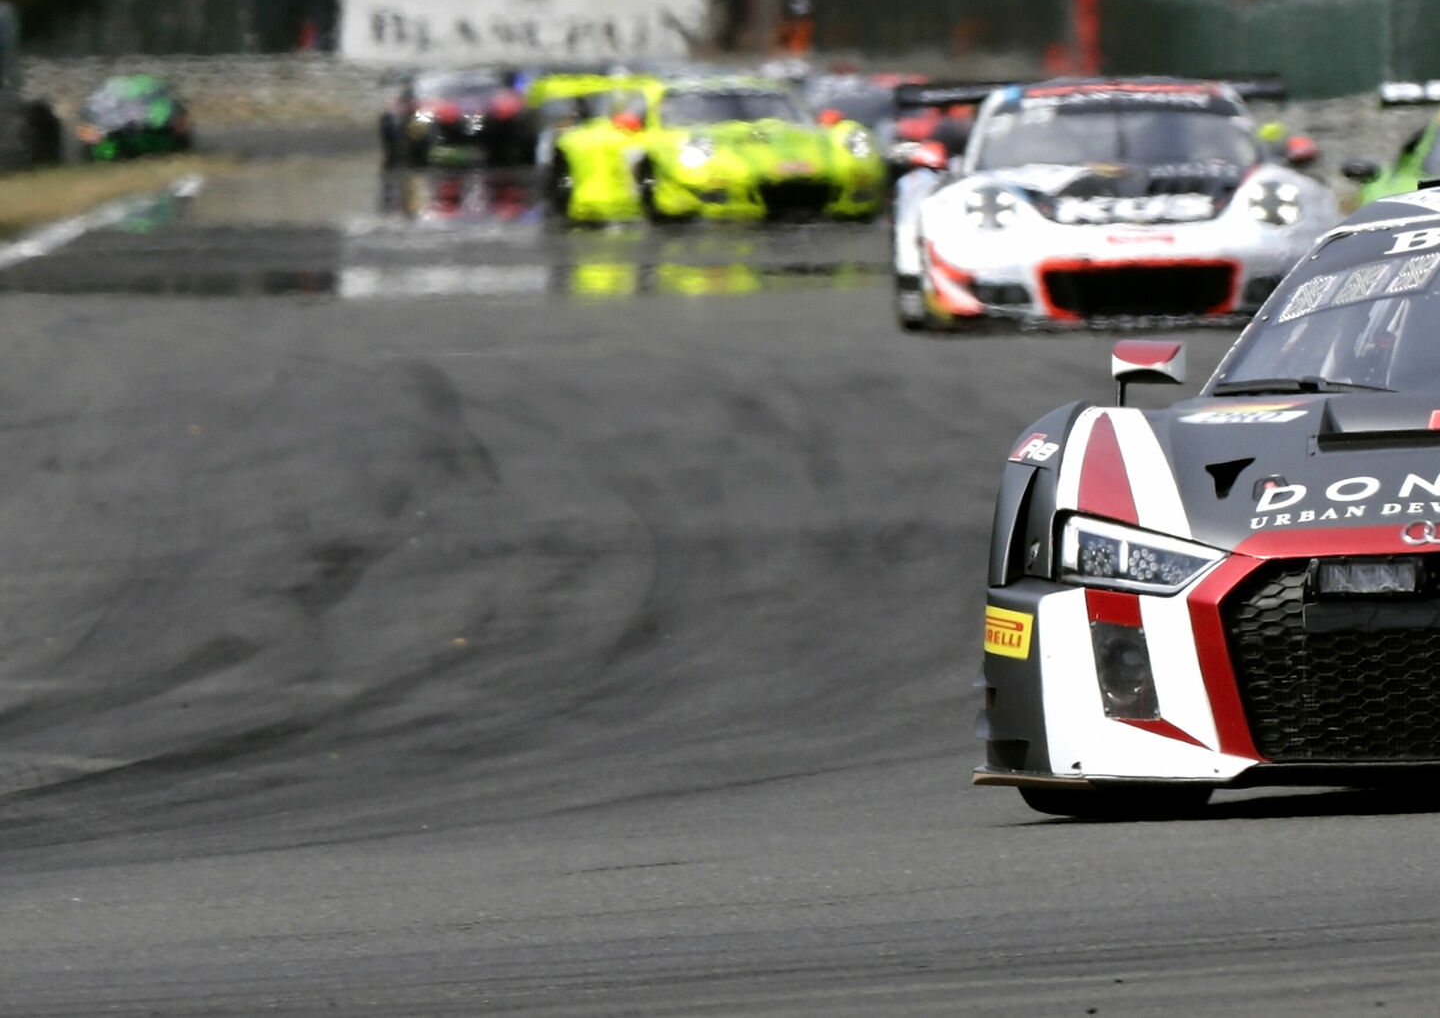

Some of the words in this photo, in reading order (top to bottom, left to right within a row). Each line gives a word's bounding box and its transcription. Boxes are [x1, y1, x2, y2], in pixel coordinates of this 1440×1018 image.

[1056, 193, 1213, 222] KUS
[1018, 439, 1059, 461] R8
[1250, 505, 1366, 529] URBAN
[985, 615, 1024, 648] RELLI
